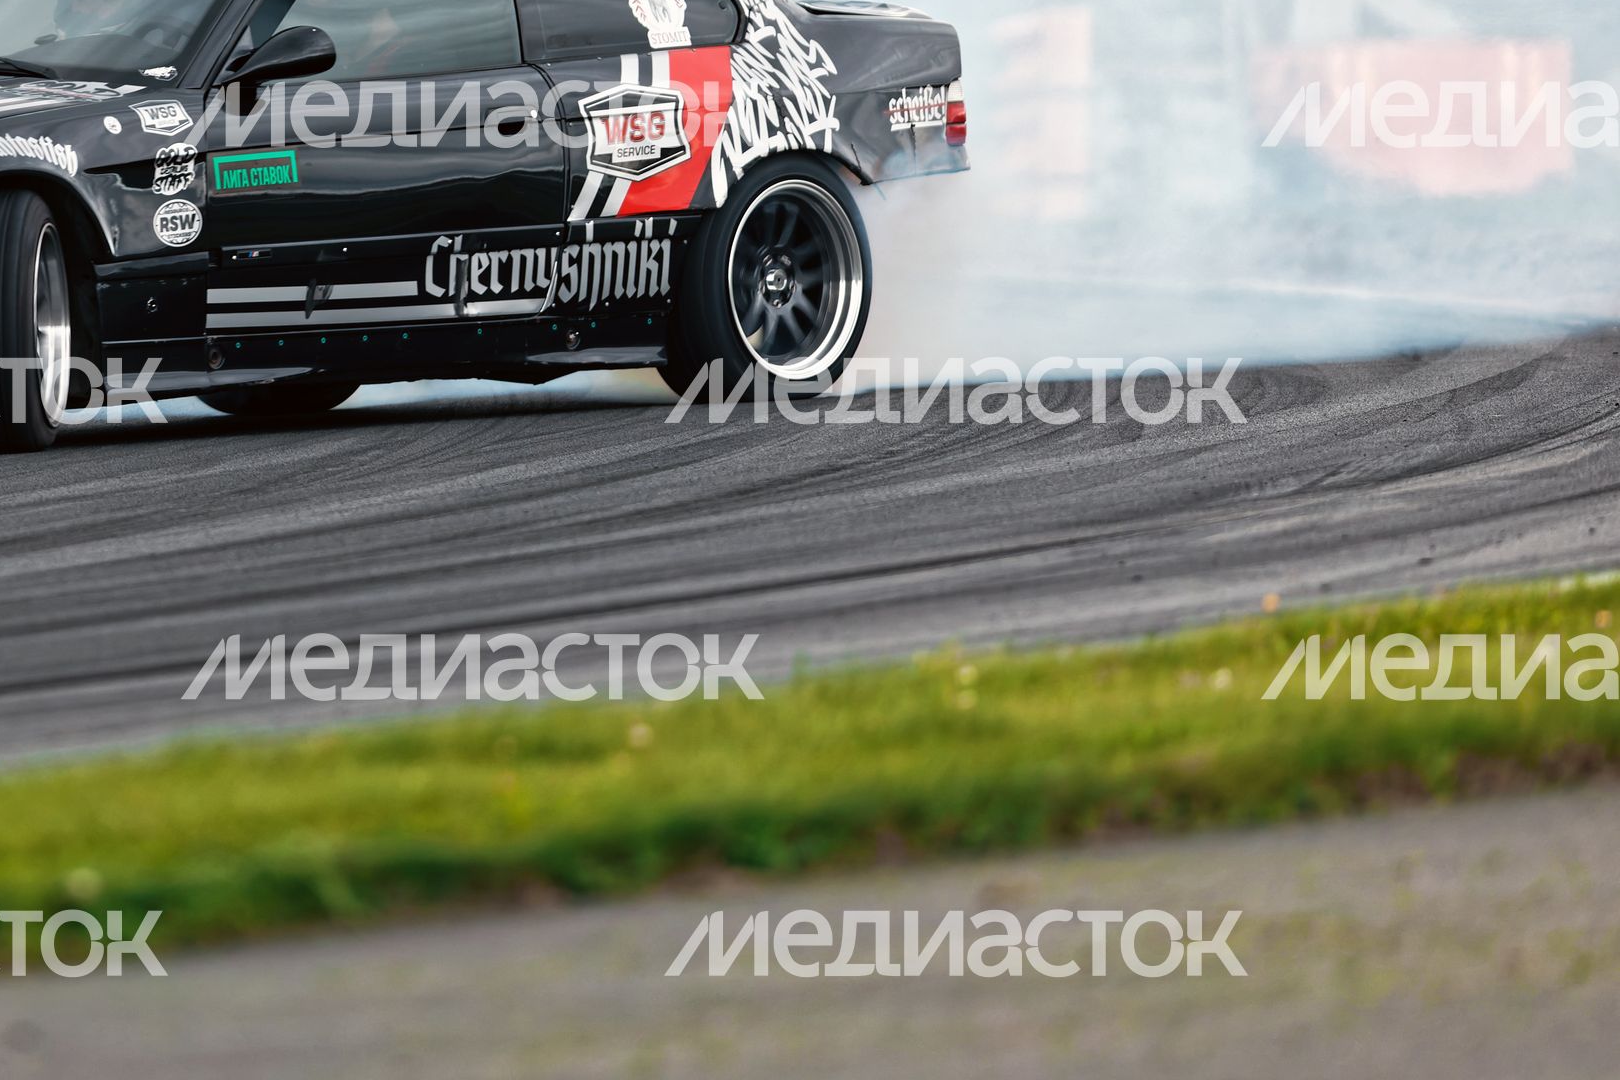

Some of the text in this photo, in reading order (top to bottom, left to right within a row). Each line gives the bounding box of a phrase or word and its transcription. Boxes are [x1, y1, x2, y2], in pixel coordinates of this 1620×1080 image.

[144, 106, 177, 120] WSG
[600, 111, 665, 145] WSG
[155, 146, 197, 168] GOLD
[617, 145, 656, 158] SERVICE
[223, 165, 291, 189] ЛИГА СТАВОК
[160, 214, 196, 232] RSW
